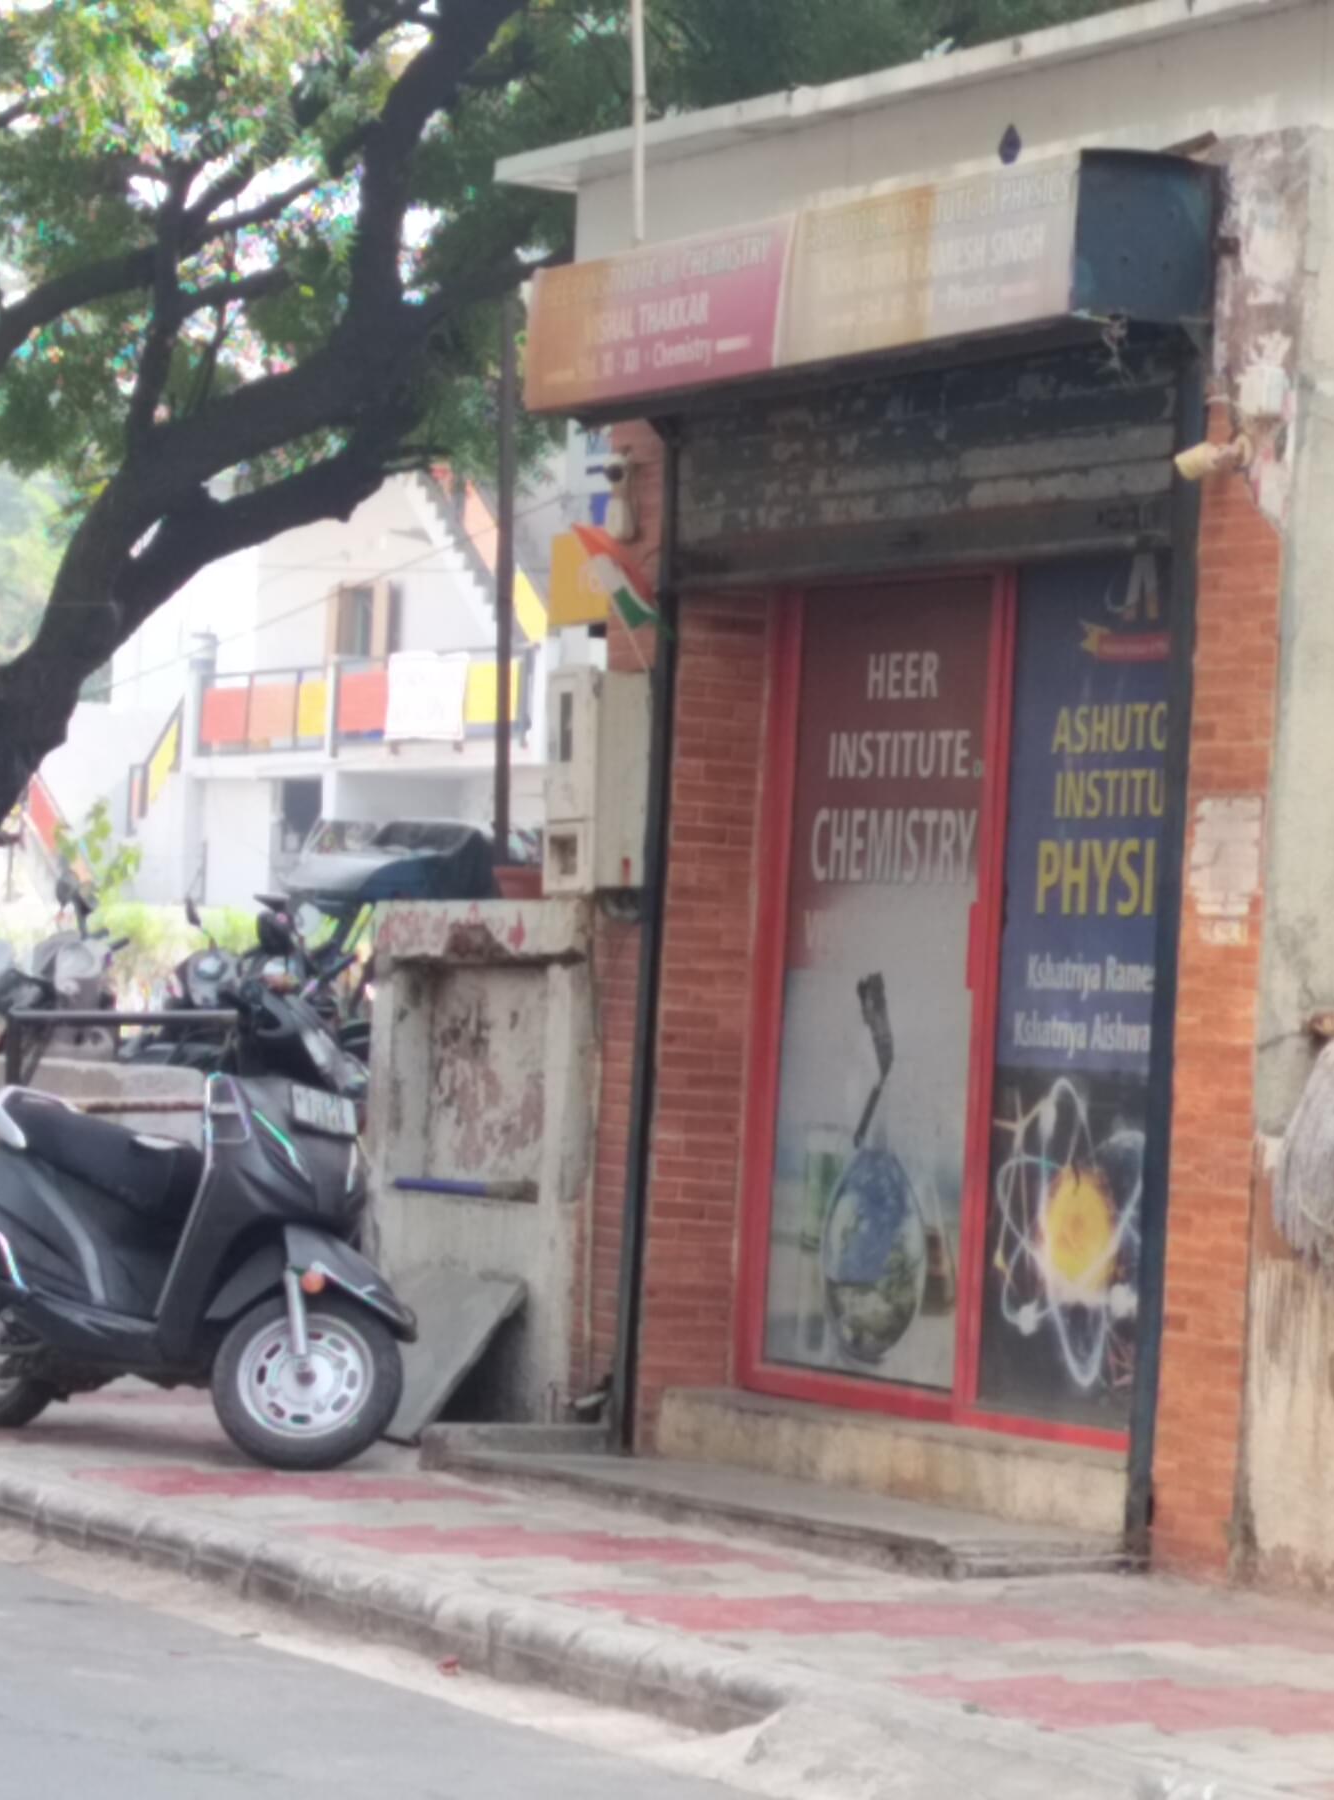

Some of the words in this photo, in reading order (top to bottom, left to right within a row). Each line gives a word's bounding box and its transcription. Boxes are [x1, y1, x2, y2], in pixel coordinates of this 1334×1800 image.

[867, 651, 940, 700] HEER
[828, 729, 971, 779] INSTITUTE
[811, 807, 979, 882] CHEMISTRY
[1035, 838, 1157, 917] PHYSI
[1026, 951, 1101, 1003] Kshatriya
[1013, 1009, 1087, 1060] Kshatriya
